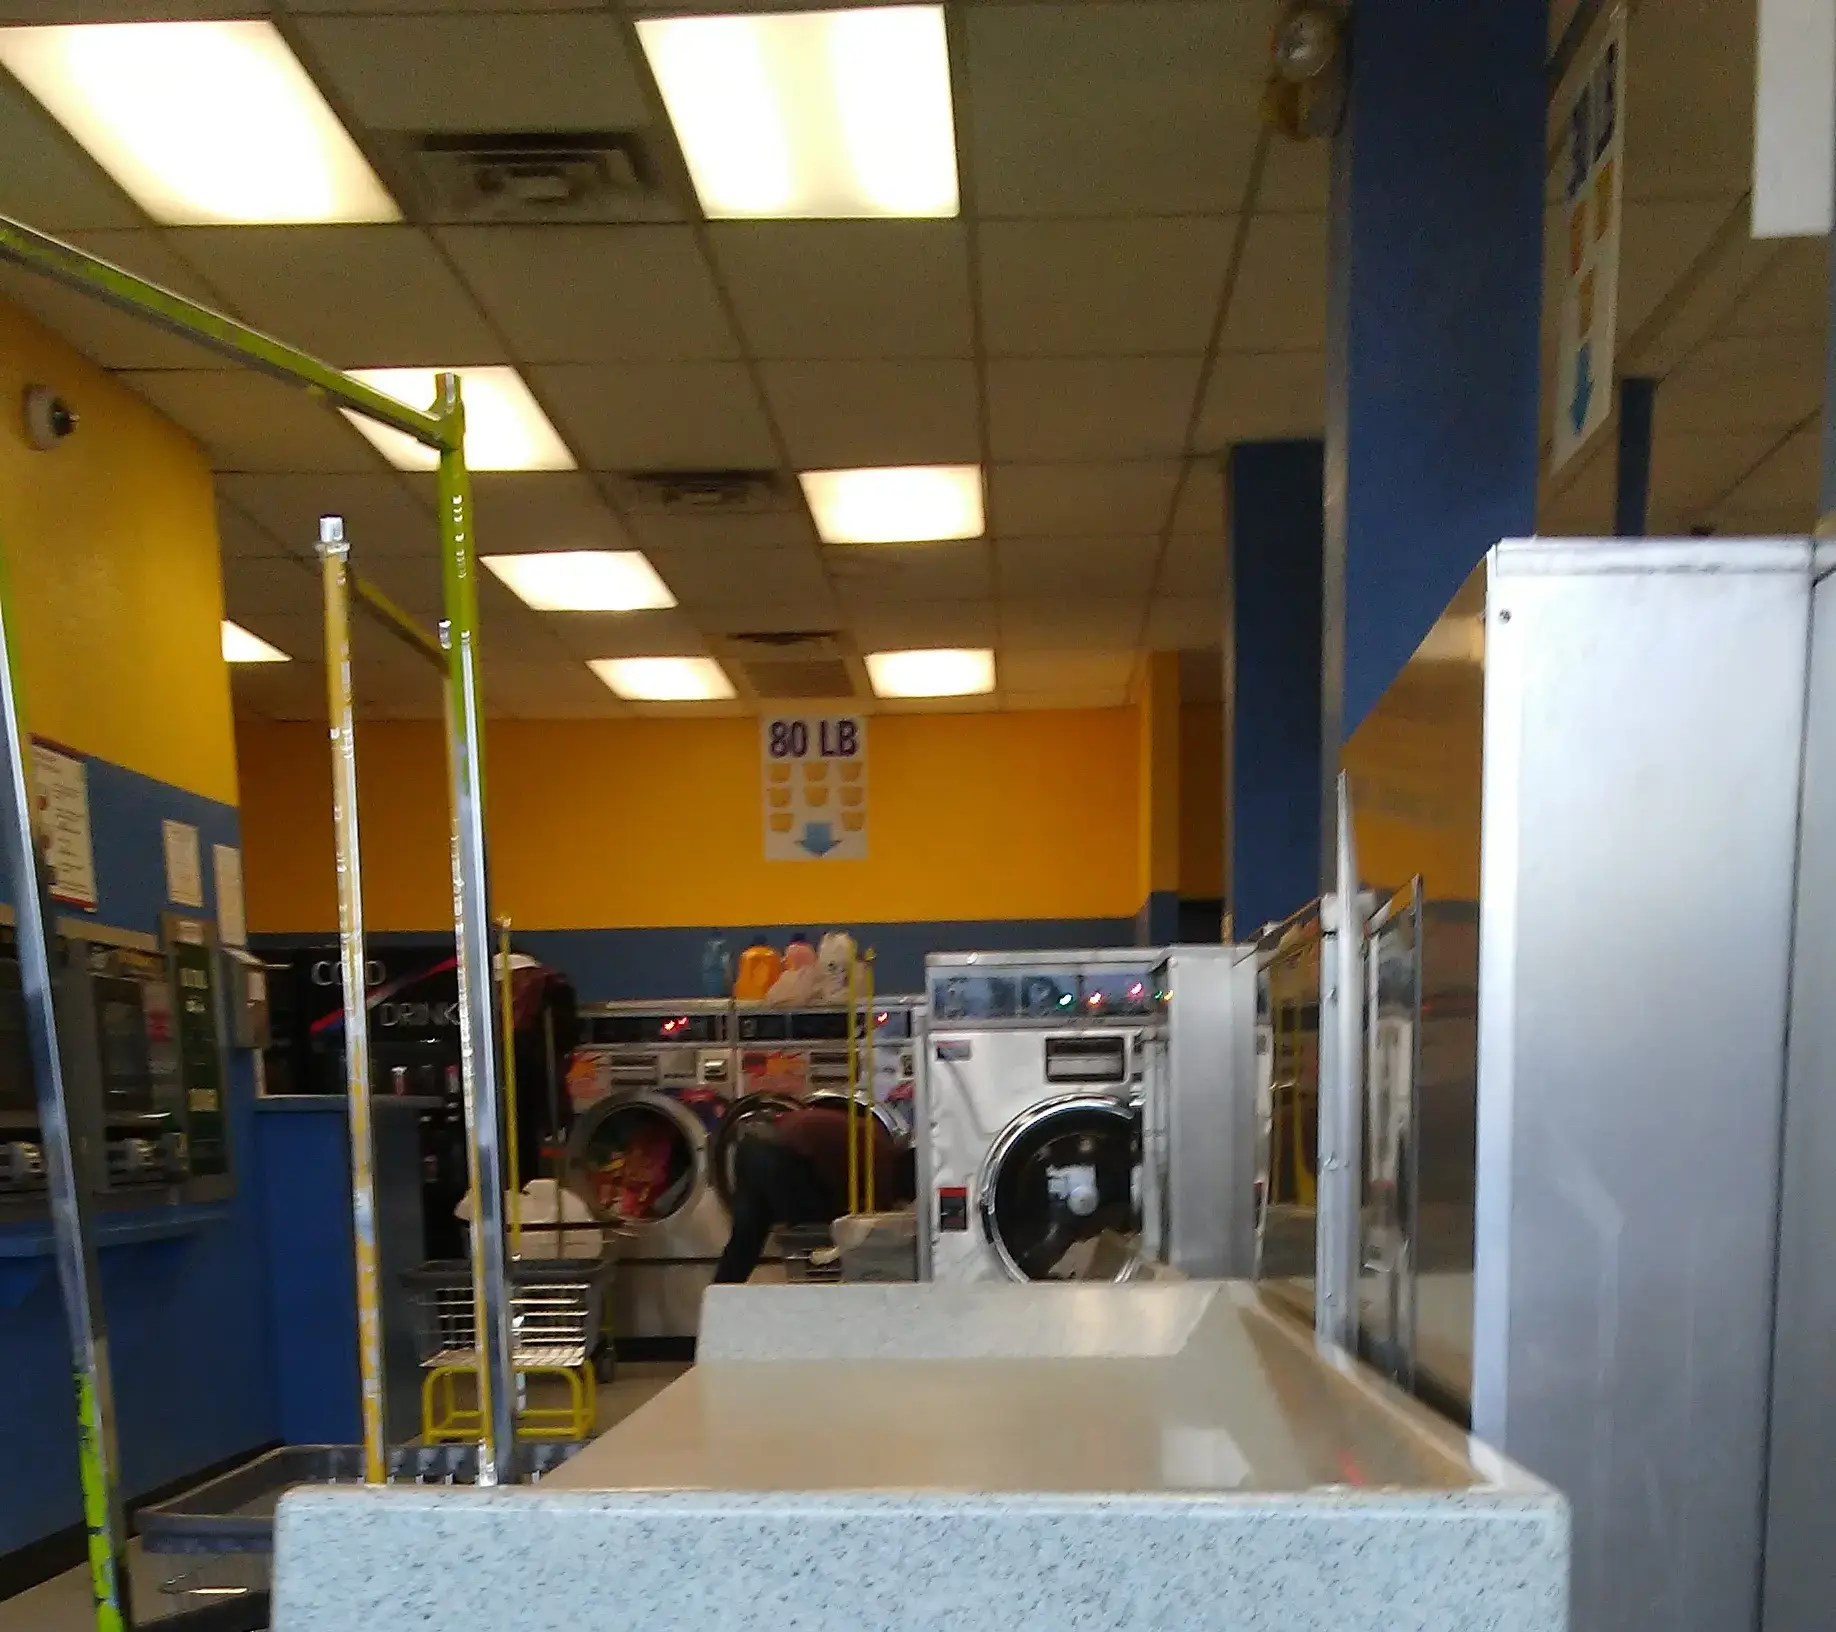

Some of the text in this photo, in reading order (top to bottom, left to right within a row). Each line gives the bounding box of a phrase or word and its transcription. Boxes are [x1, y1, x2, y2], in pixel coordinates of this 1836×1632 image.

[769, 718, 859, 758] 80 LB
[310, 959, 387, 987] CD
